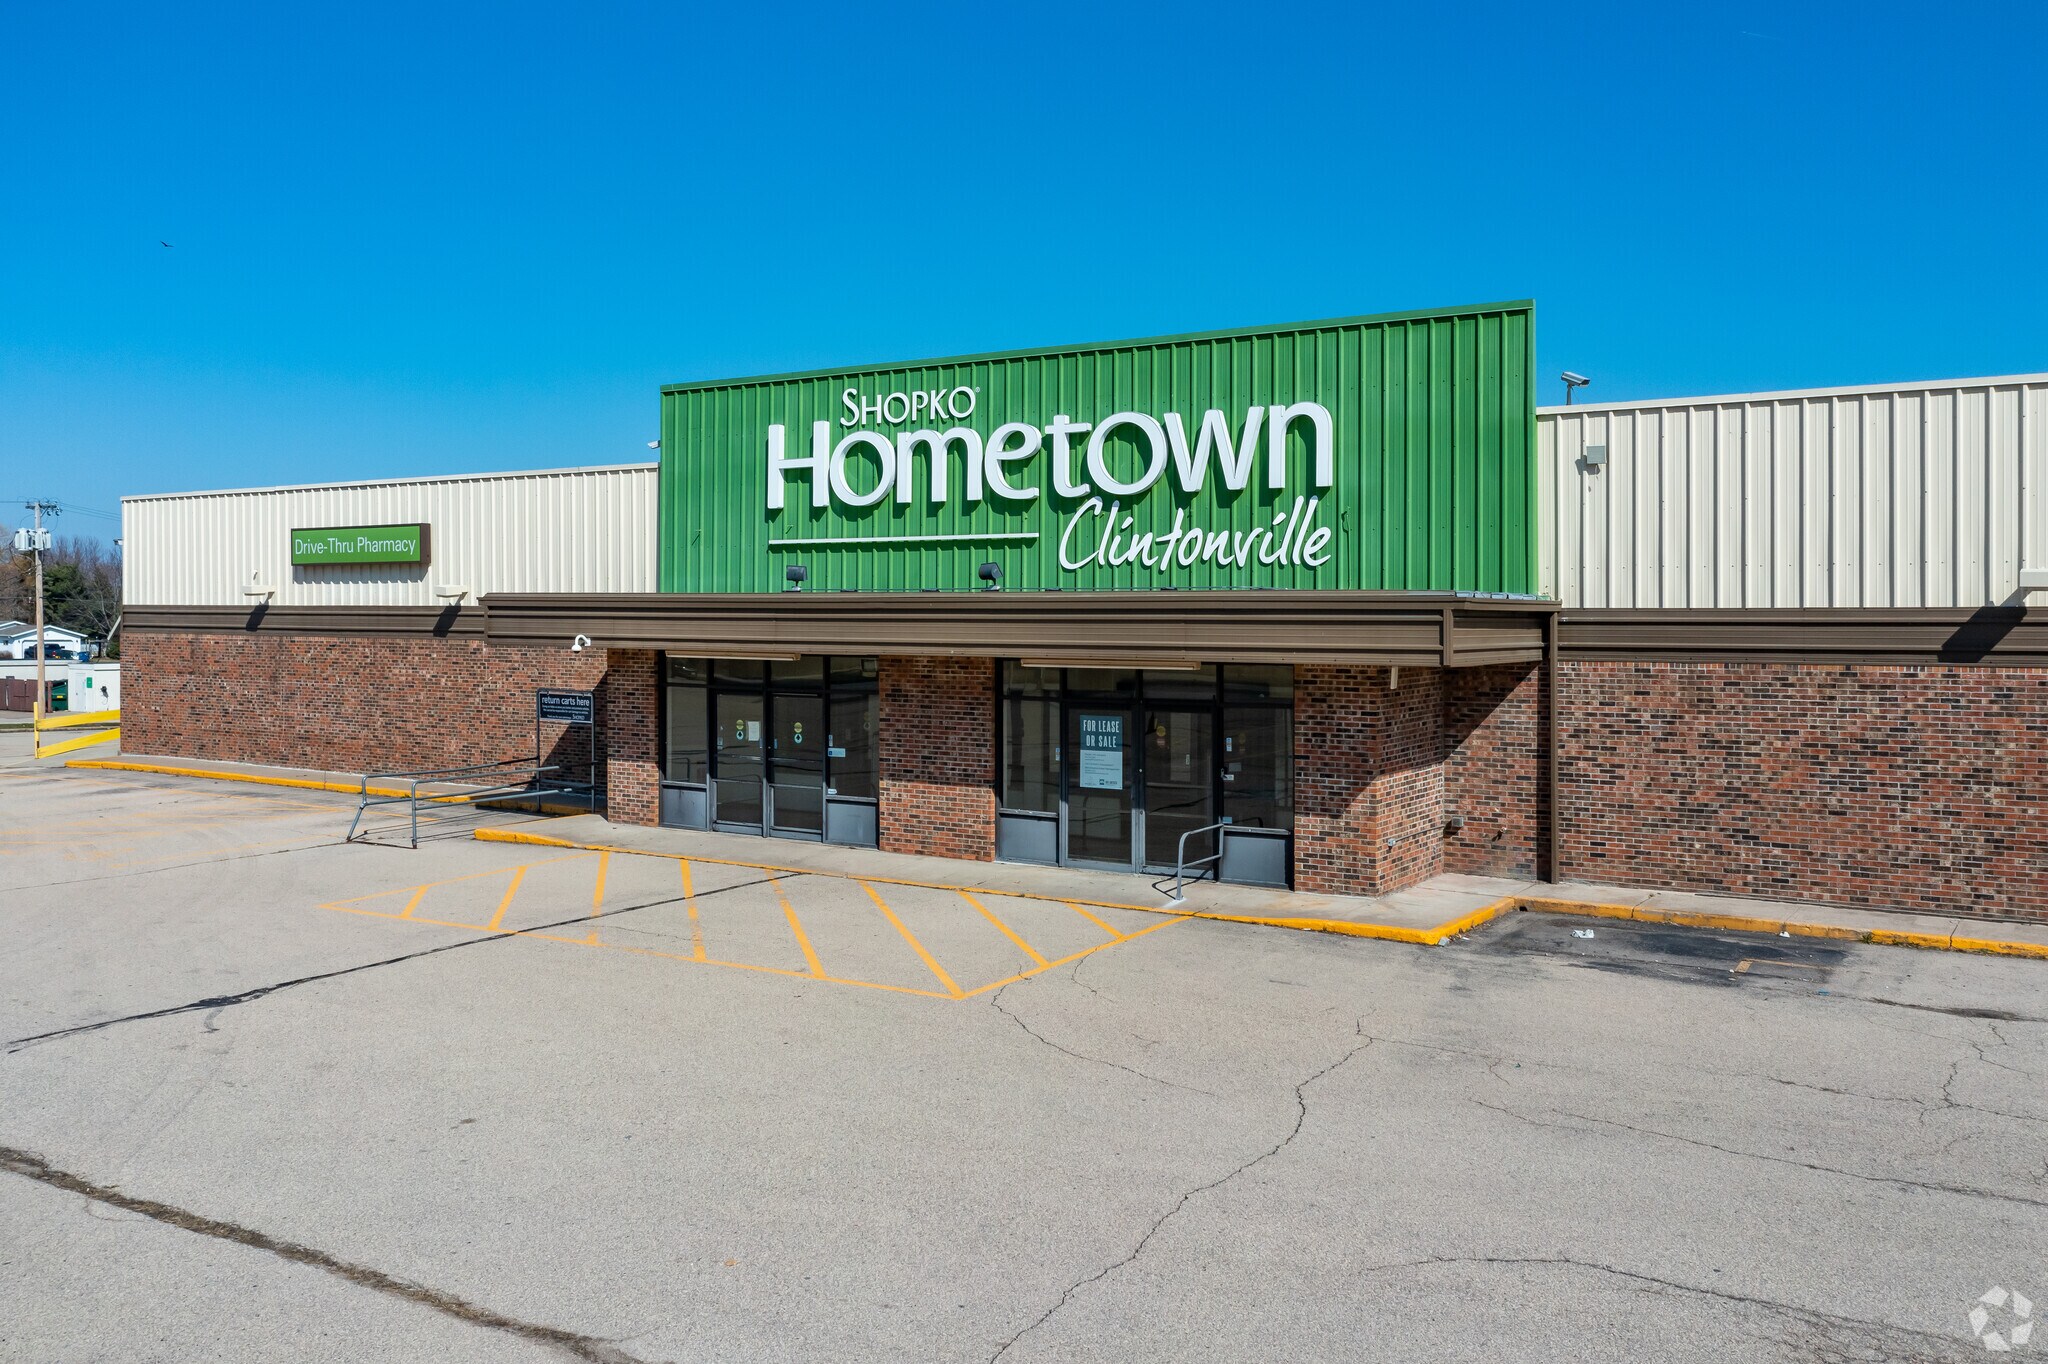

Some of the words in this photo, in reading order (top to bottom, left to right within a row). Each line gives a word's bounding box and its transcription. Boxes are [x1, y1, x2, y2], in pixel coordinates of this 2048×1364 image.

[767, 401, 1333, 509] Hometown
[1059, 495, 1331, 571] Clintonville
[295, 538, 354, 555] Drive-Thru
[357, 537, 416, 555] Pharmacy
[542, 697, 560, 705] return
[561, 697, 575, 706] carts
[576, 696, 590, 706] here
[1083, 720, 1096, 732] FOR
[1098, 720, 1120, 733] LEASE
[1086, 735, 1096, 747] OR
[1098, 736, 1117, 748] SALE
